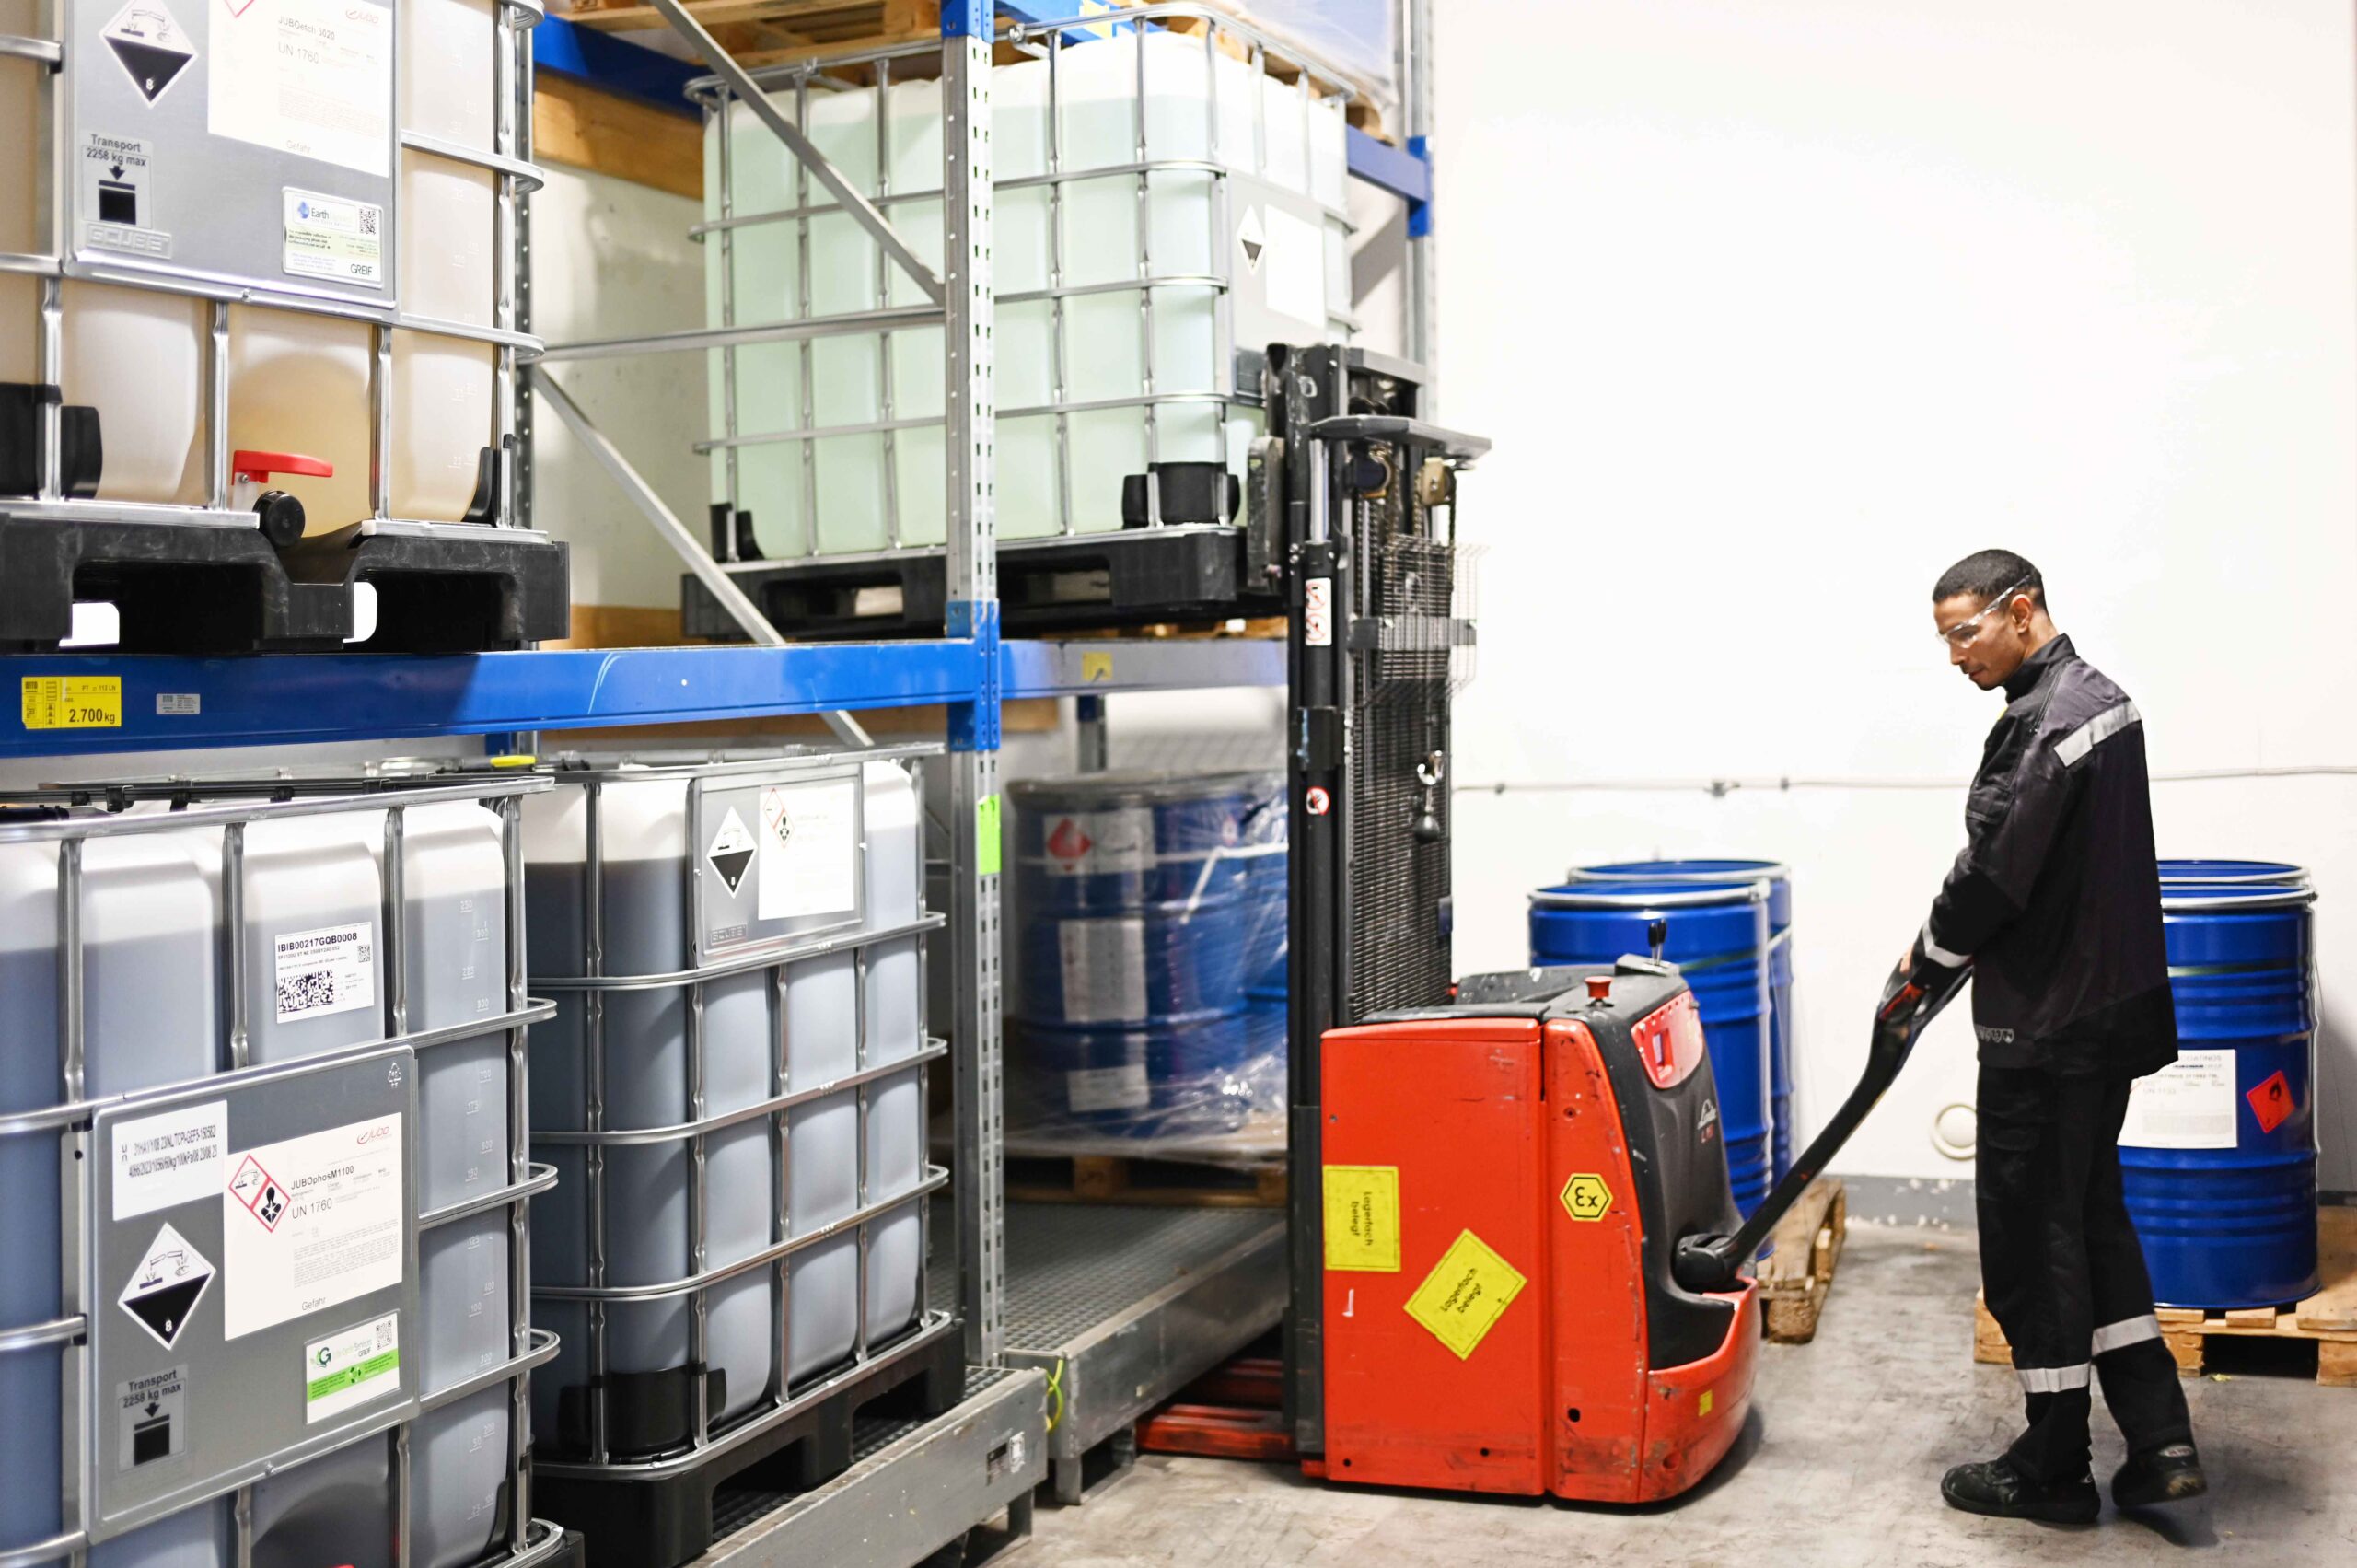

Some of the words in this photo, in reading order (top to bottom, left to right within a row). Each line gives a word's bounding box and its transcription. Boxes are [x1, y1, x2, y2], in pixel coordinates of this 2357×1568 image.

[278, 41, 294, 56] UN
[296, 48, 319, 64] 1760
[145, 79, 155, 90] 8
[91, 134, 141, 152] Transport
[87, 147, 110, 161] 2258
[111, 152, 123, 166] kg
[126, 156, 146, 167] max
[311, 208, 330, 220] Earth
[351, 264, 373, 276] GREIF
[69, 708, 103, 723] 2.700
[105, 713, 115, 725] kg
[278, 932, 358, 953] IBIB00217GQB0008
[291, 1165, 354, 1190] JUBOphosM1100
[292, 1203, 307, 1219] UN
[310, 1197, 332, 1214] 1760
[1350, 1201, 1360, 1236] belegt
[1363, 1191, 1374, 1246] Lagerfach
[1440, 1268, 1477, 1312] Lagerfach
[302, 1296, 326, 1311] Gefahr
[165, 1319, 173, 1333] 8
[128, 1370, 177, 1392] Transport
[148, 1389, 159, 1400] kg
[162, 1383, 181, 1396] max
